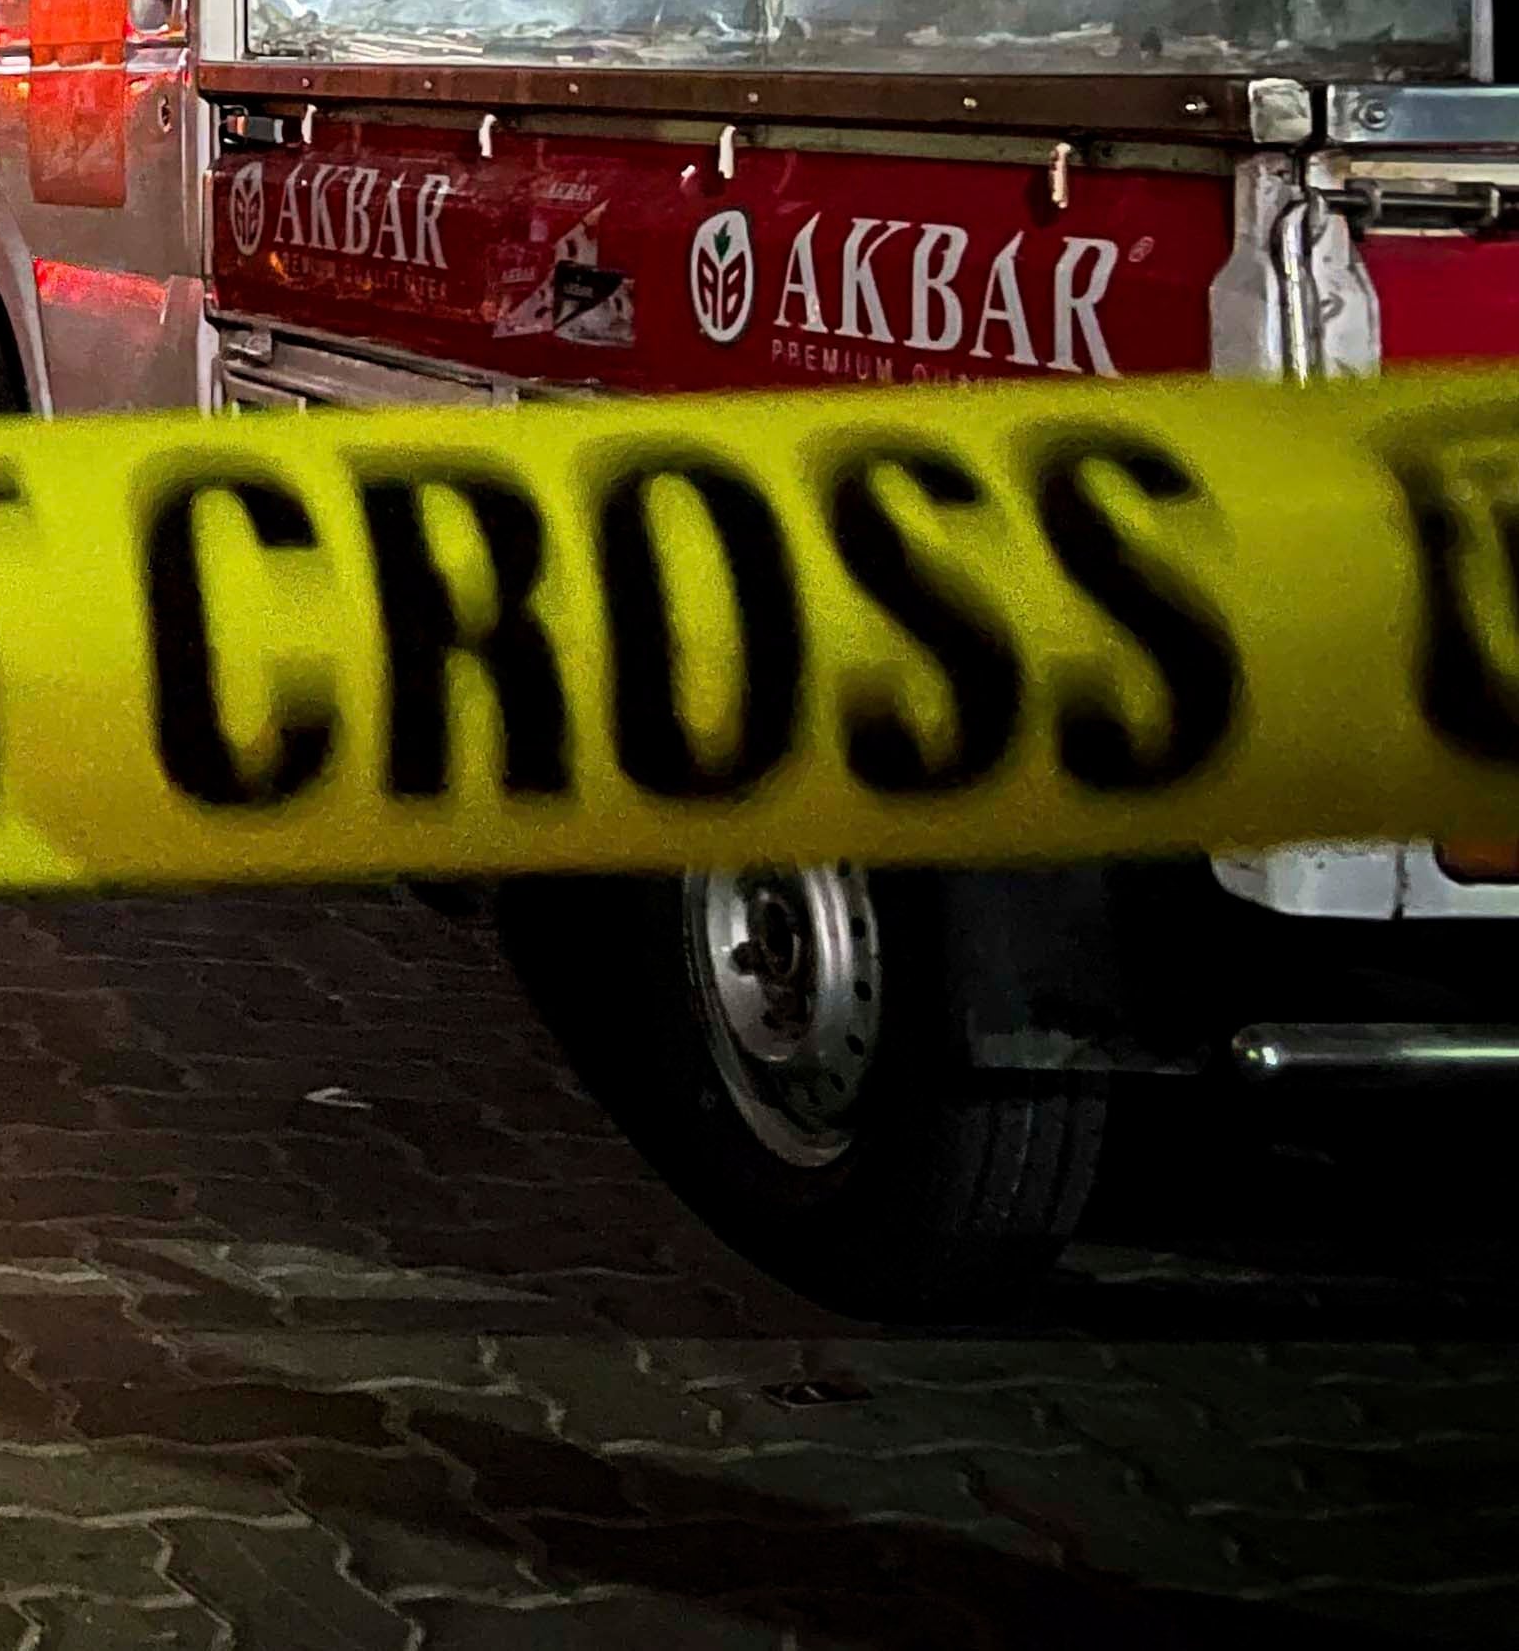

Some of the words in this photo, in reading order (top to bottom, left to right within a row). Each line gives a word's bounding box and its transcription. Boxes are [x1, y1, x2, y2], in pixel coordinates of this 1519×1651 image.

[274, 161, 451, 270] AKBAR
[771, 339, 894, 384] PREMIUM
[773, 211, 1125, 380] AKBAR
[133, 418, 1247, 805] CROSS
